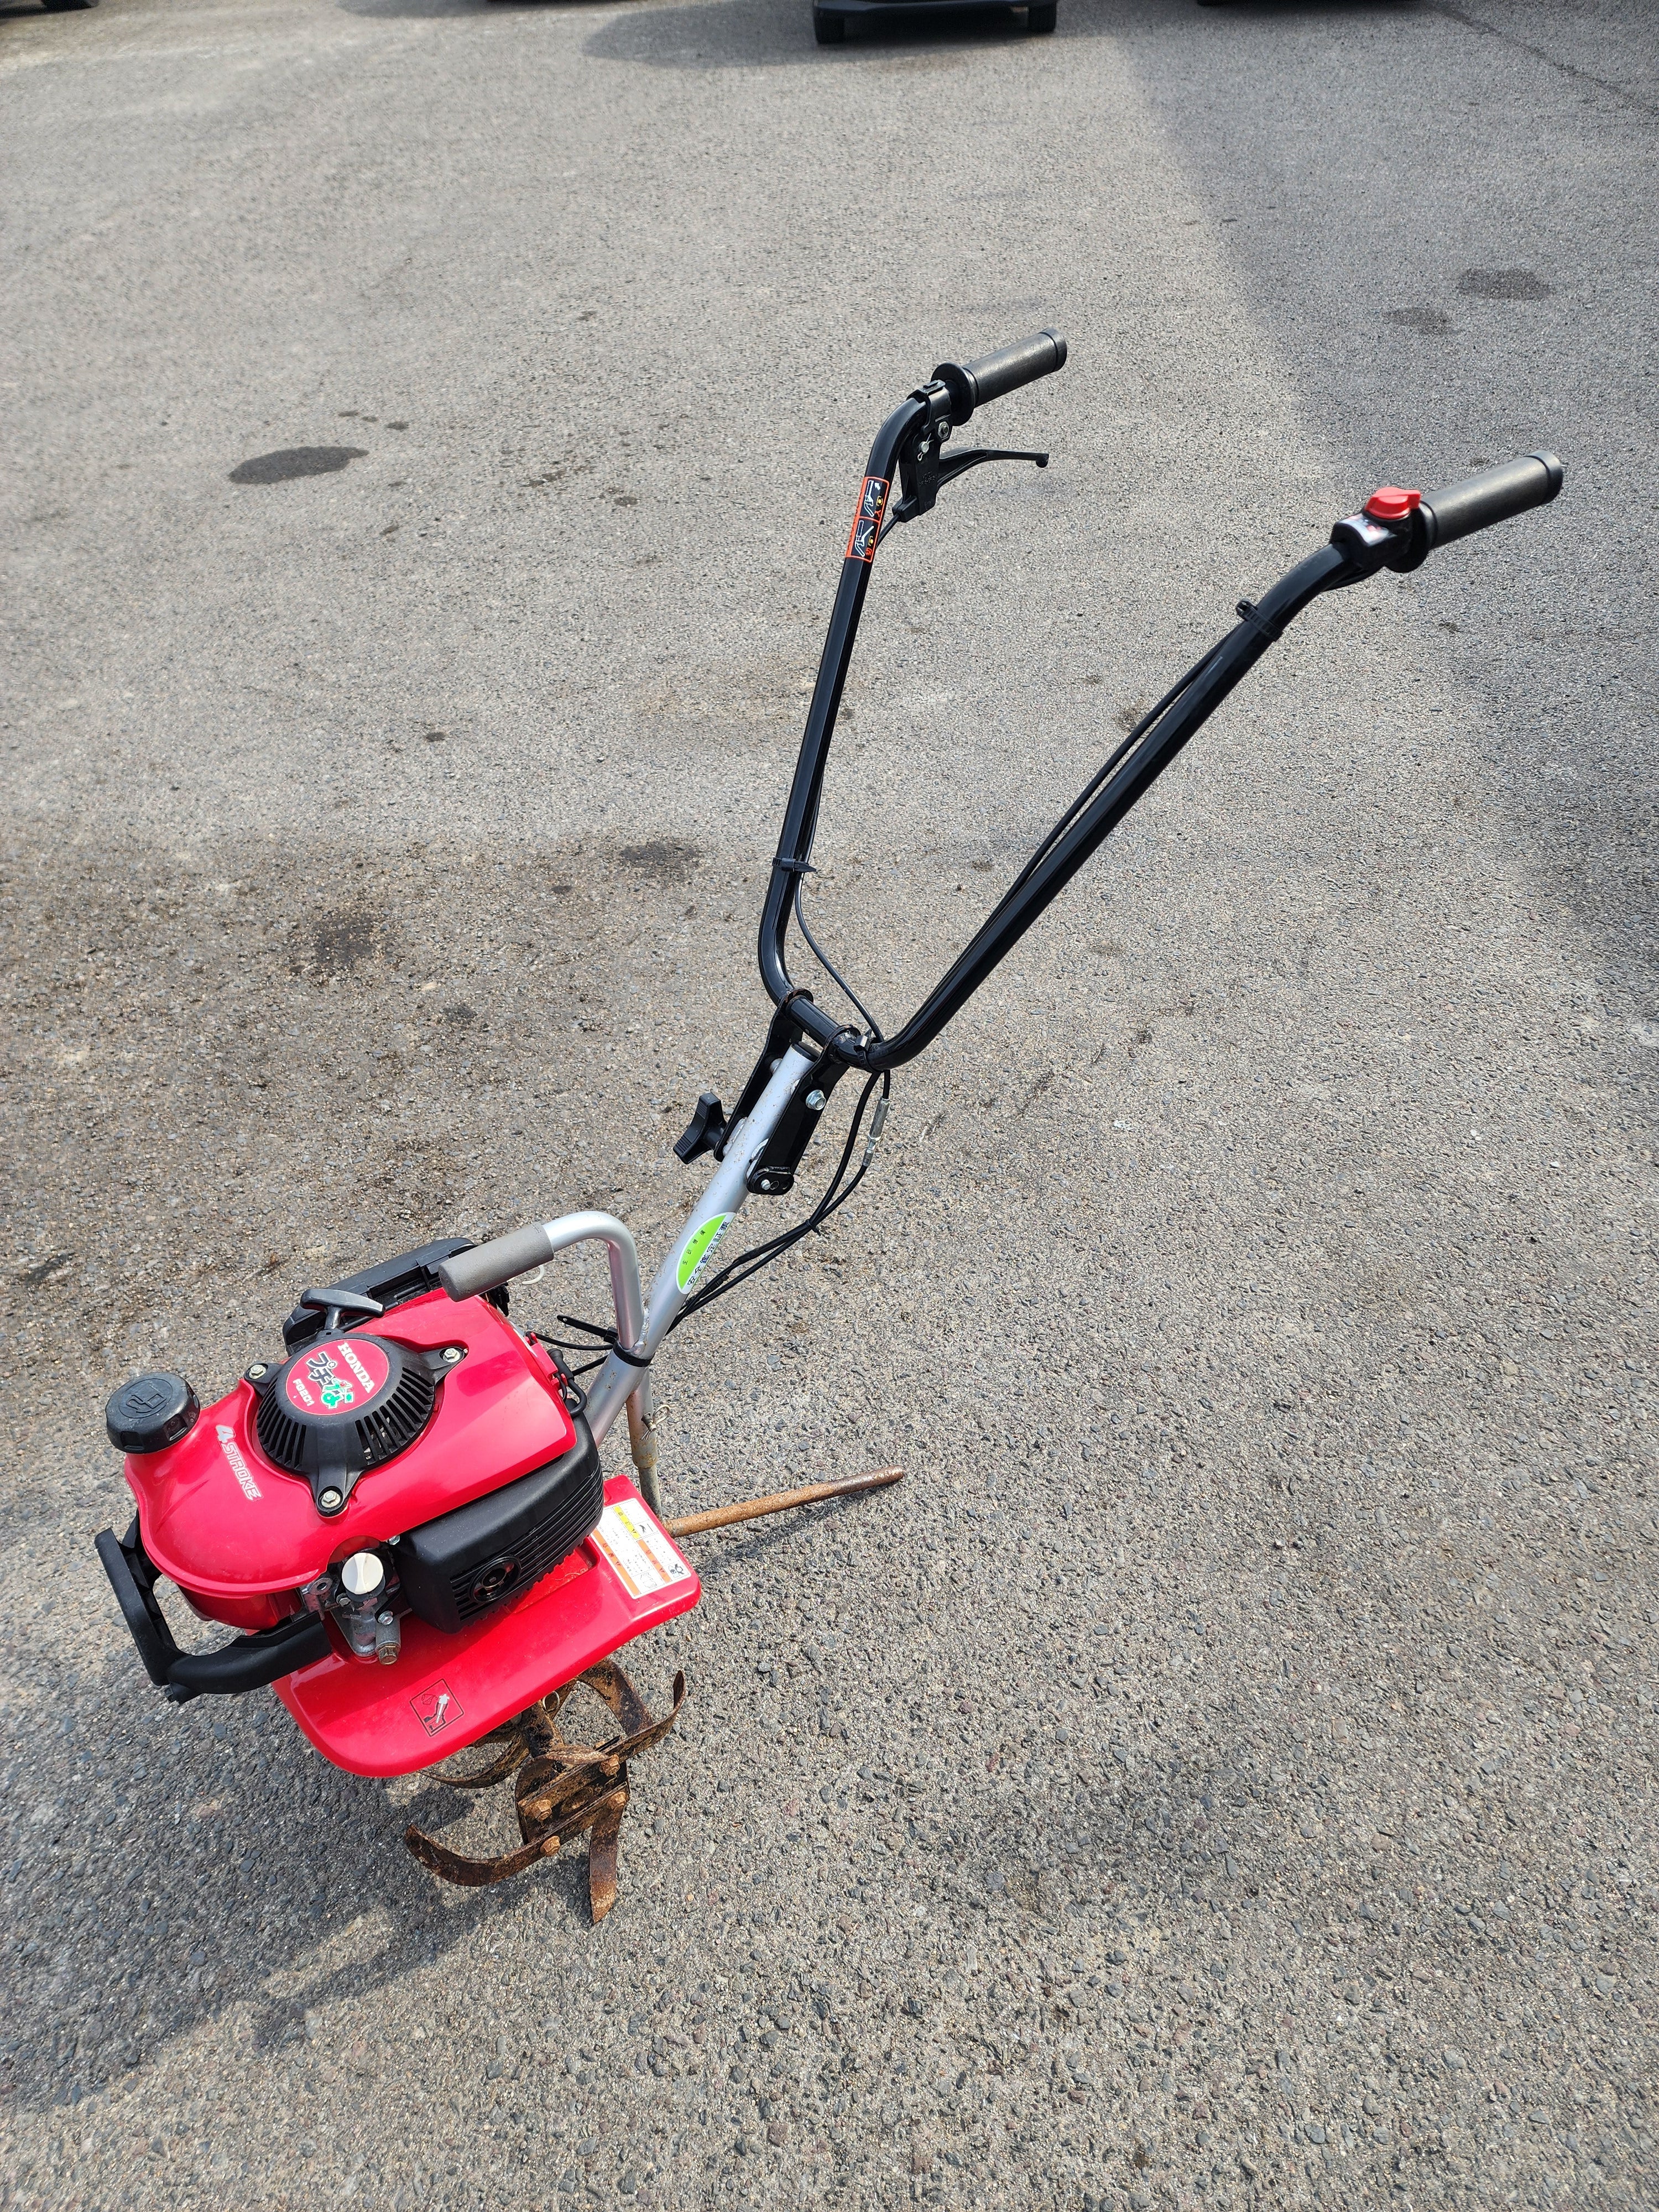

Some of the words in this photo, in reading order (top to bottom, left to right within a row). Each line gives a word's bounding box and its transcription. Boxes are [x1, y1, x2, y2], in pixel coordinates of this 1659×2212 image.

[337, 1342, 375, 1393] HONDA
[293, 1378, 315, 1406] FG201
[216, 1425, 234, 1443] 4
[221, 1442, 262, 1501] STROKE
